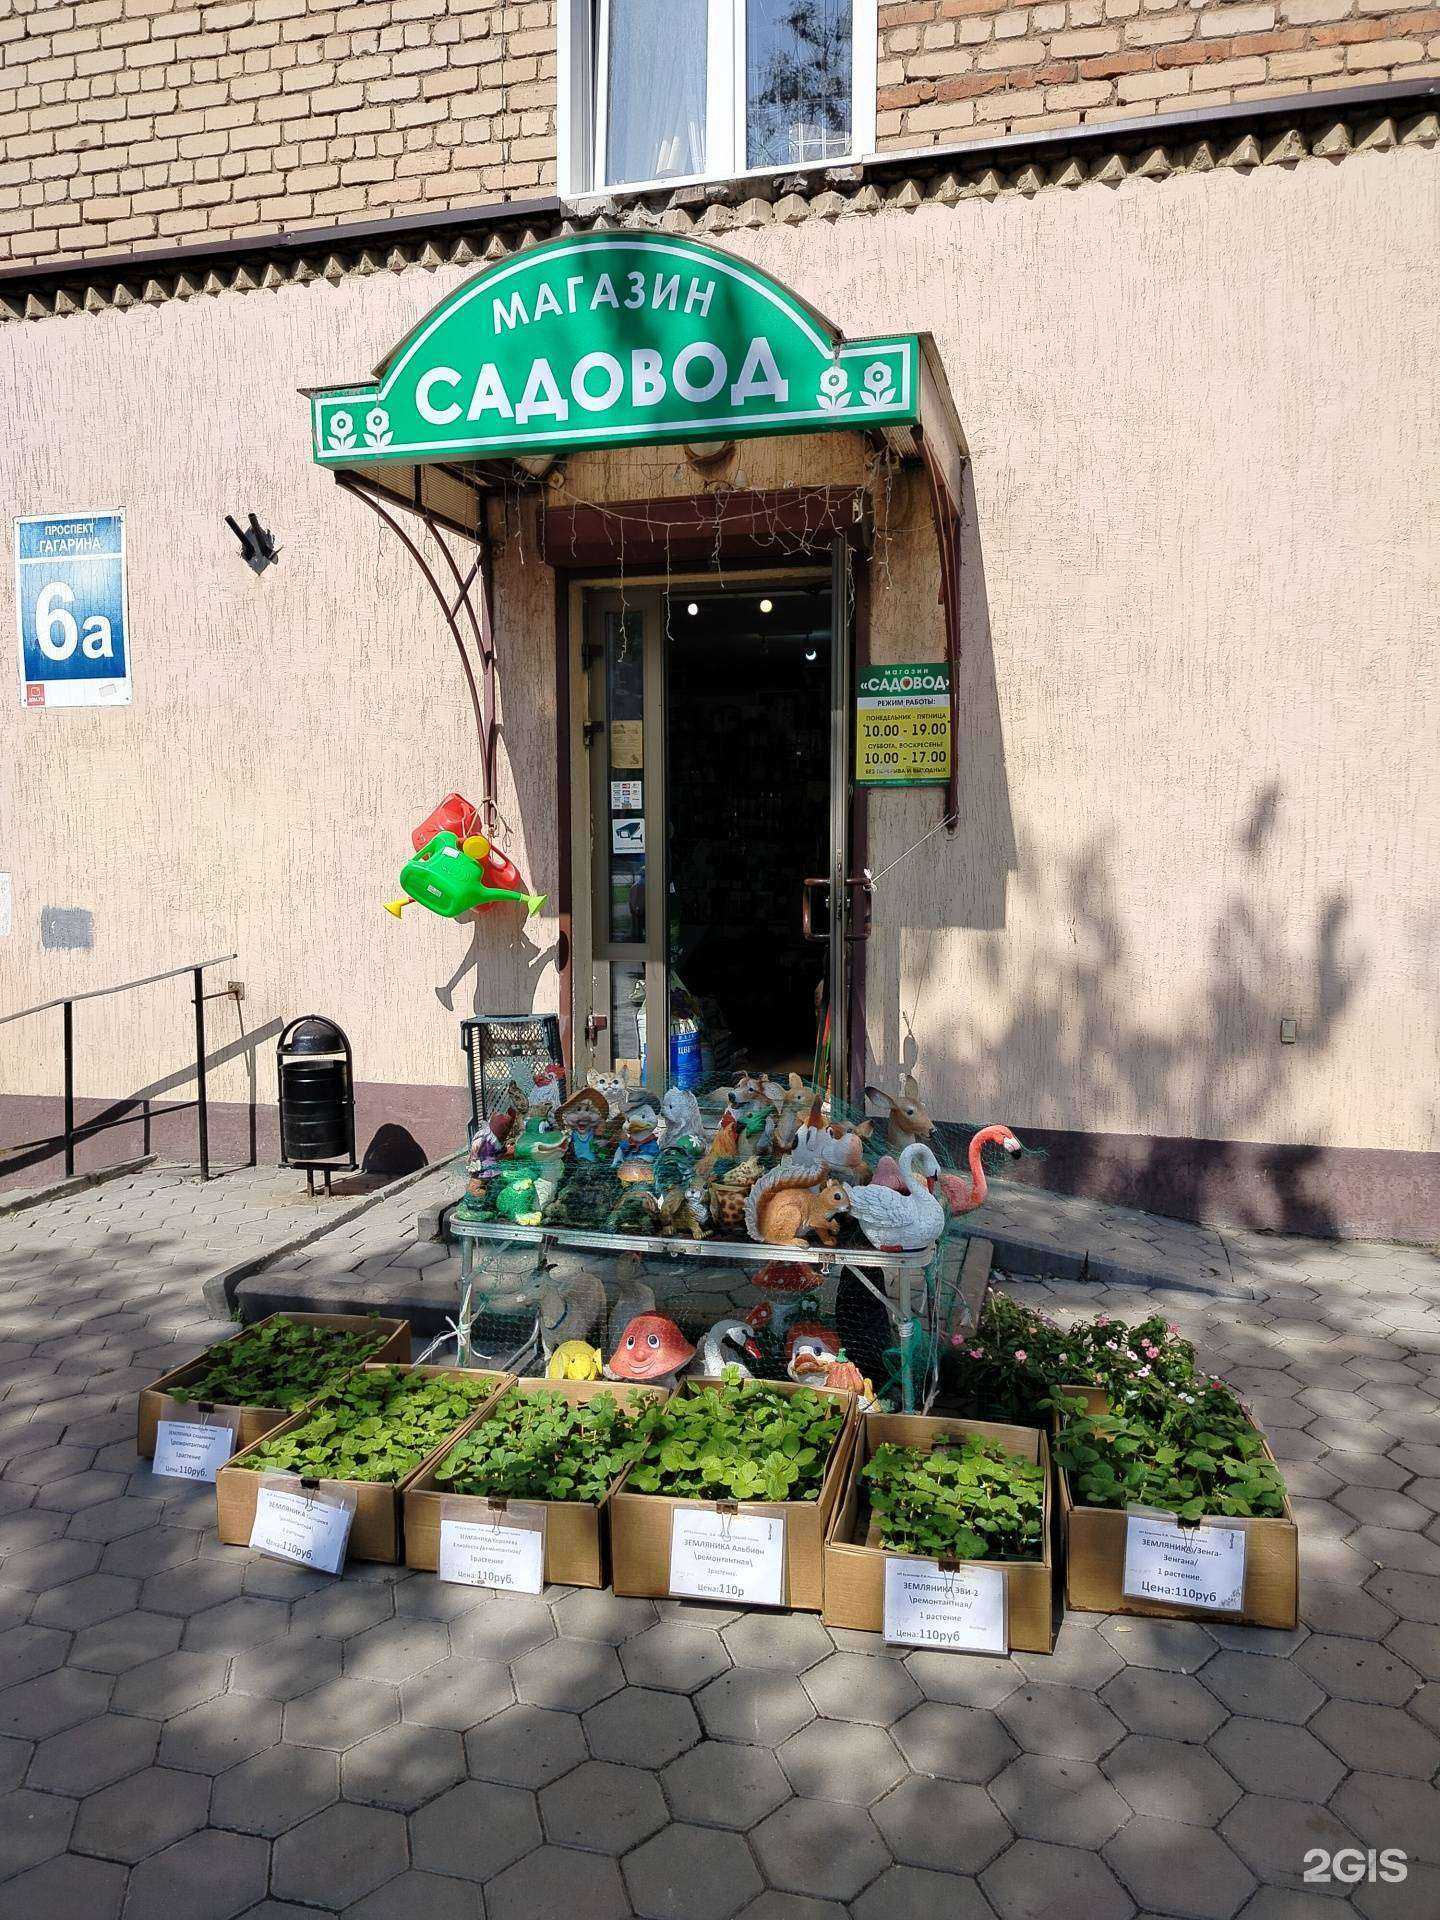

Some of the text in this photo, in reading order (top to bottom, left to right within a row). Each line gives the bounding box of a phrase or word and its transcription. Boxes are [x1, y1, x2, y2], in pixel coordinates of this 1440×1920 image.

[491, 271, 717, 335] МАГАЗИН
[414, 336, 790, 425] САДОВОД
[44, 523, 95, 536] ПРОСПЕКТ
[39, 538, 102, 553] ГАГАРИНА
[35, 581, 114, 661] 6а
[877, 698, 936, 707] РЕЖИМ РАБОТЫ:
[865, 724, 899, 737] 10.00
[912, 722, 947, 736] 19.00
[865, 752, 899, 764] 10.00
[911, 750, 946, 763] 17.00
[683, 1539, 765, 1556] ЗЕМЛЯНИКА Альбион
[1141, 1538, 1193, 1552] ЗЕМЛЯНИКА
[903, 1581, 953, 1593] ЗЕМЛЯНИКА
[919, 1611, 962, 1622] 1 растение
